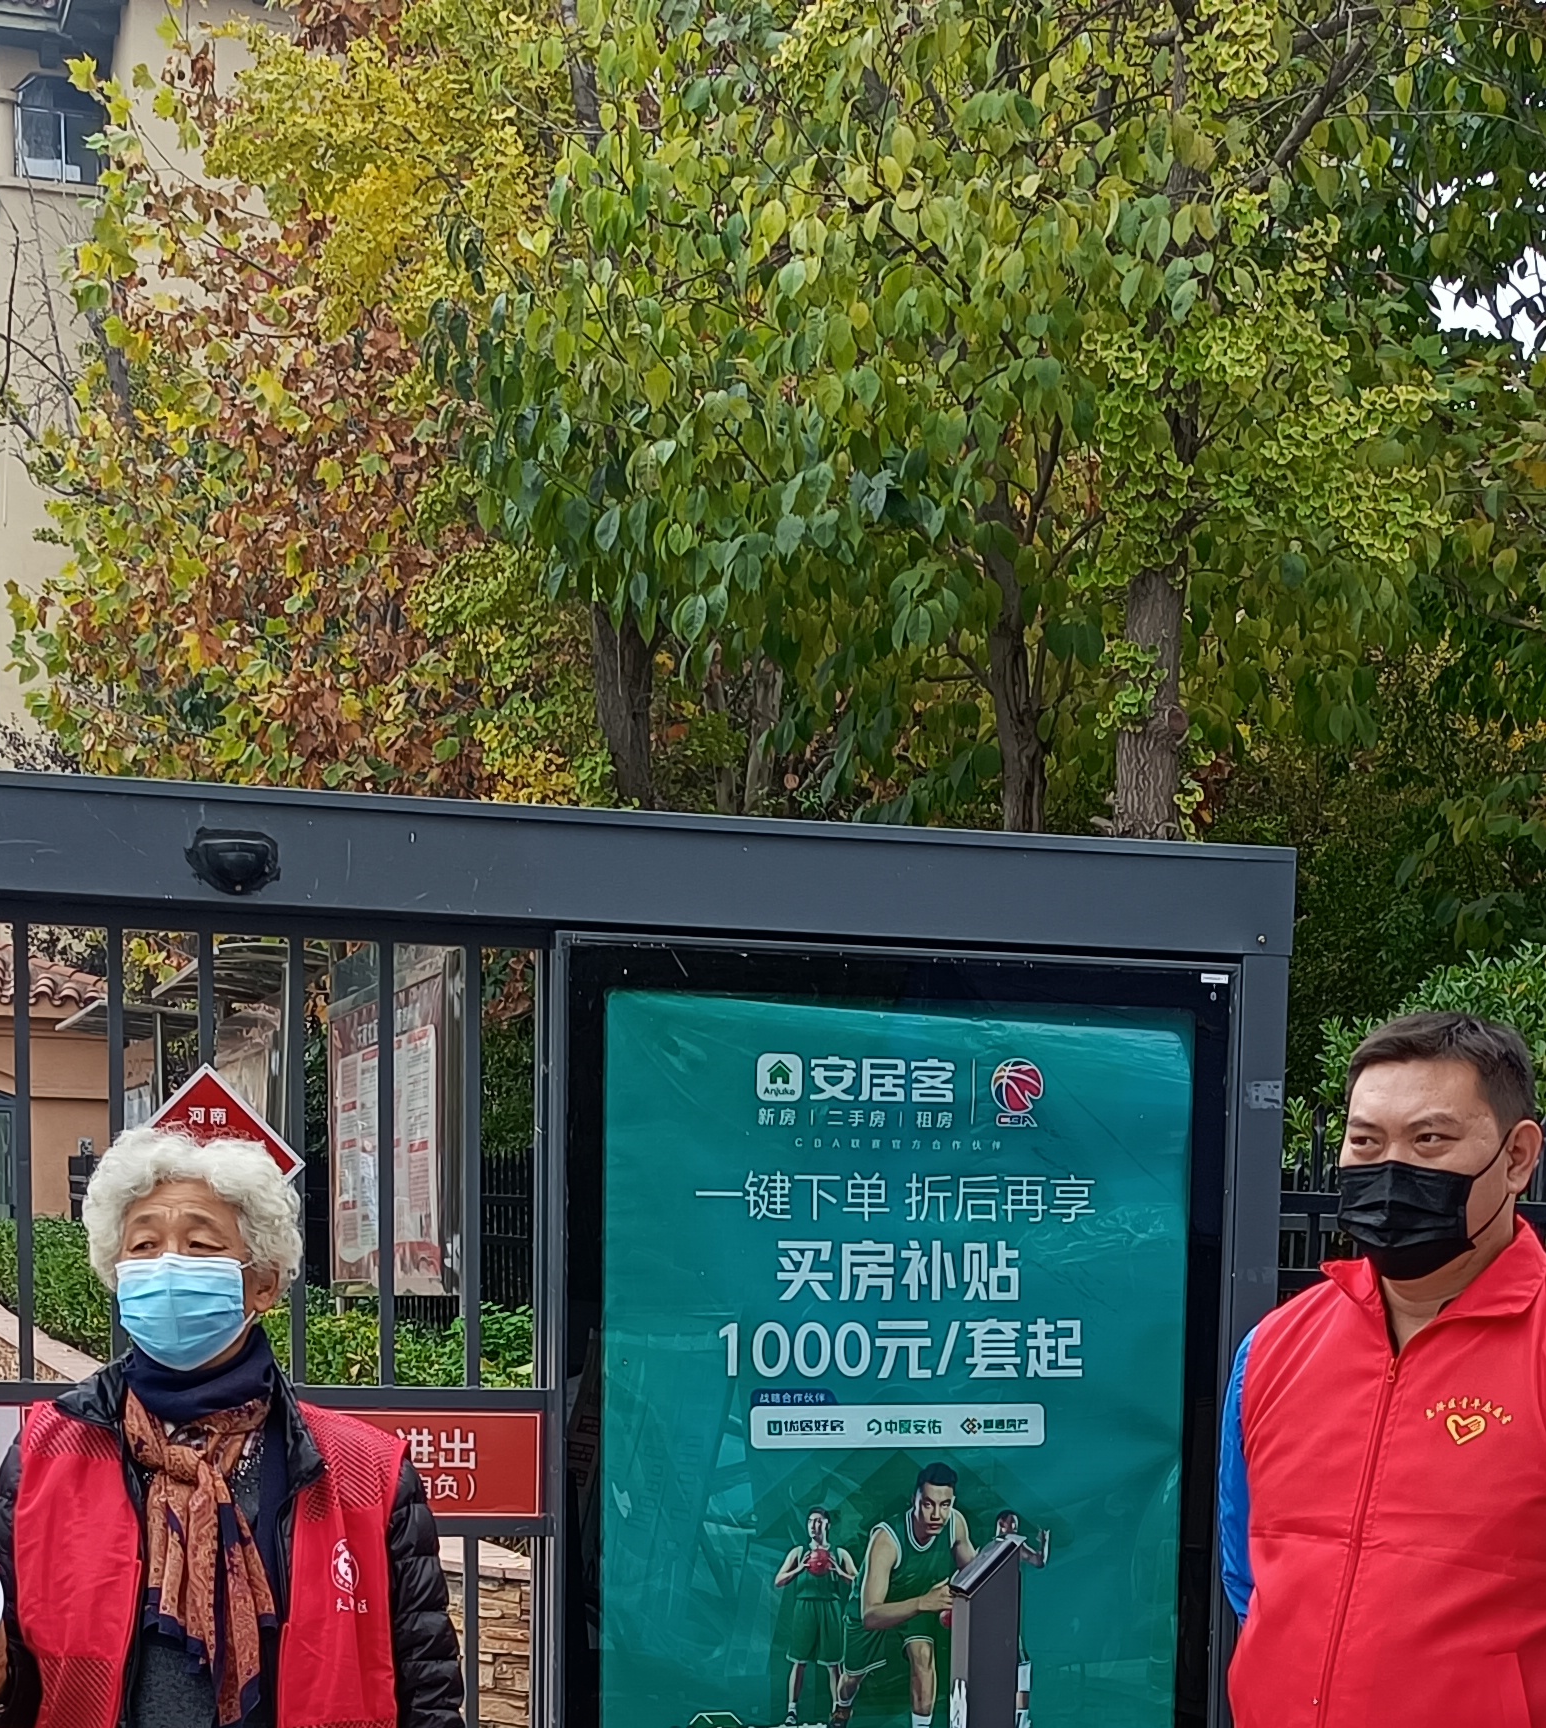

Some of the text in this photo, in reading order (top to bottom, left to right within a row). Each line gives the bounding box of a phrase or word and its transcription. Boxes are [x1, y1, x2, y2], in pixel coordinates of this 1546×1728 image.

[809, 1056, 956, 1103] 安居客
[188, 1106, 227, 1125] 河南
[758, 1108, 953, 1128] 新房 二手房 租房
[694, 1171, 1096, 1223] 一键下单 折后再享
[775, 1240, 1021, 1302] 买房补贴
[718, 1316, 1085, 1380] 1000元/套起
